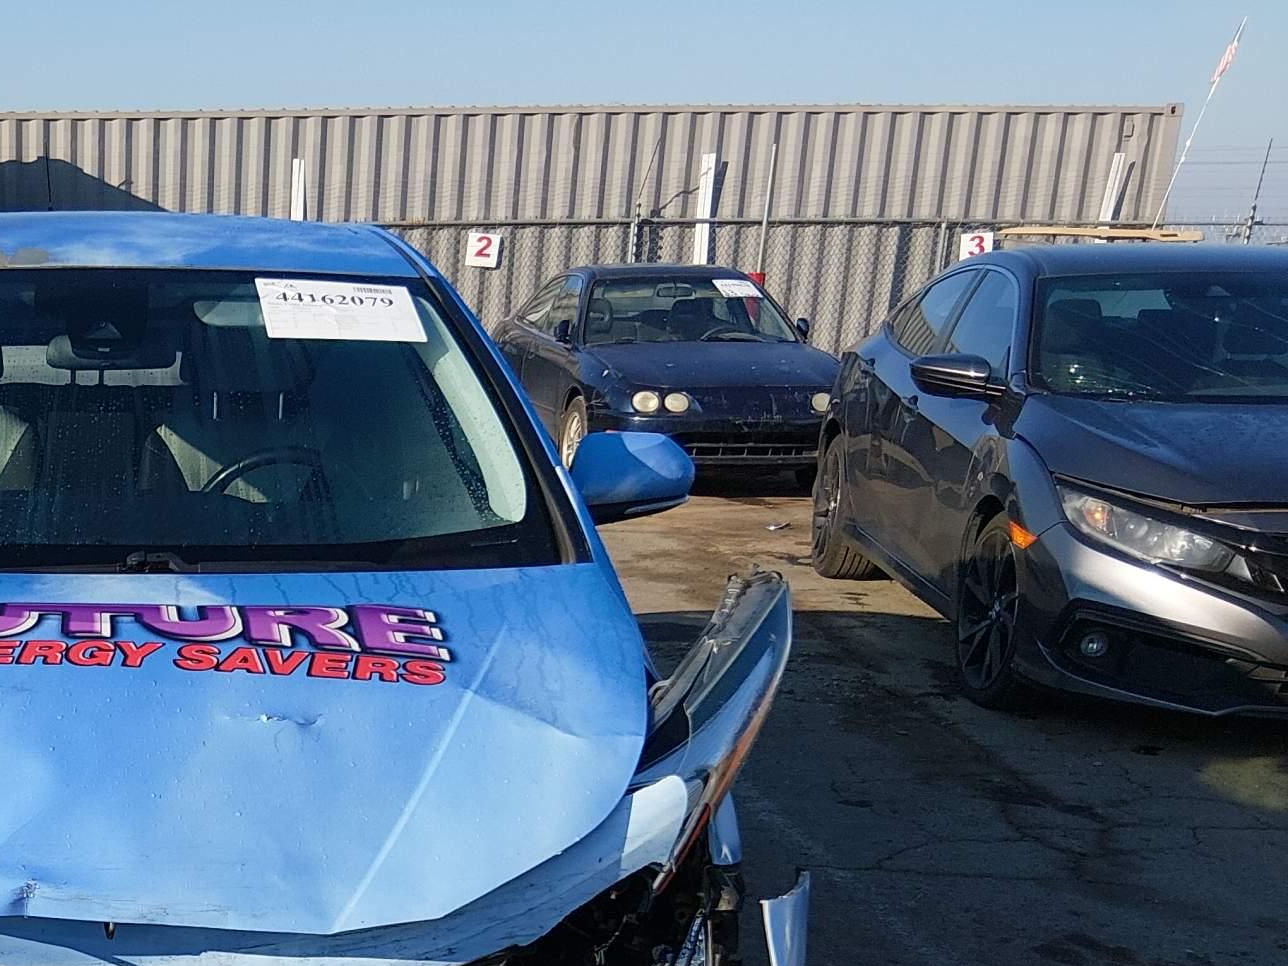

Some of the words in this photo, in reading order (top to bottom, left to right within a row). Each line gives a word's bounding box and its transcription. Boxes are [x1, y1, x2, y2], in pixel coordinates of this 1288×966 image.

[474, 236, 493, 258] 2
[968, 235, 985, 257] 3
[275, 291, 394, 309] 44162079
[172, 643, 447, 686] SAVERS
